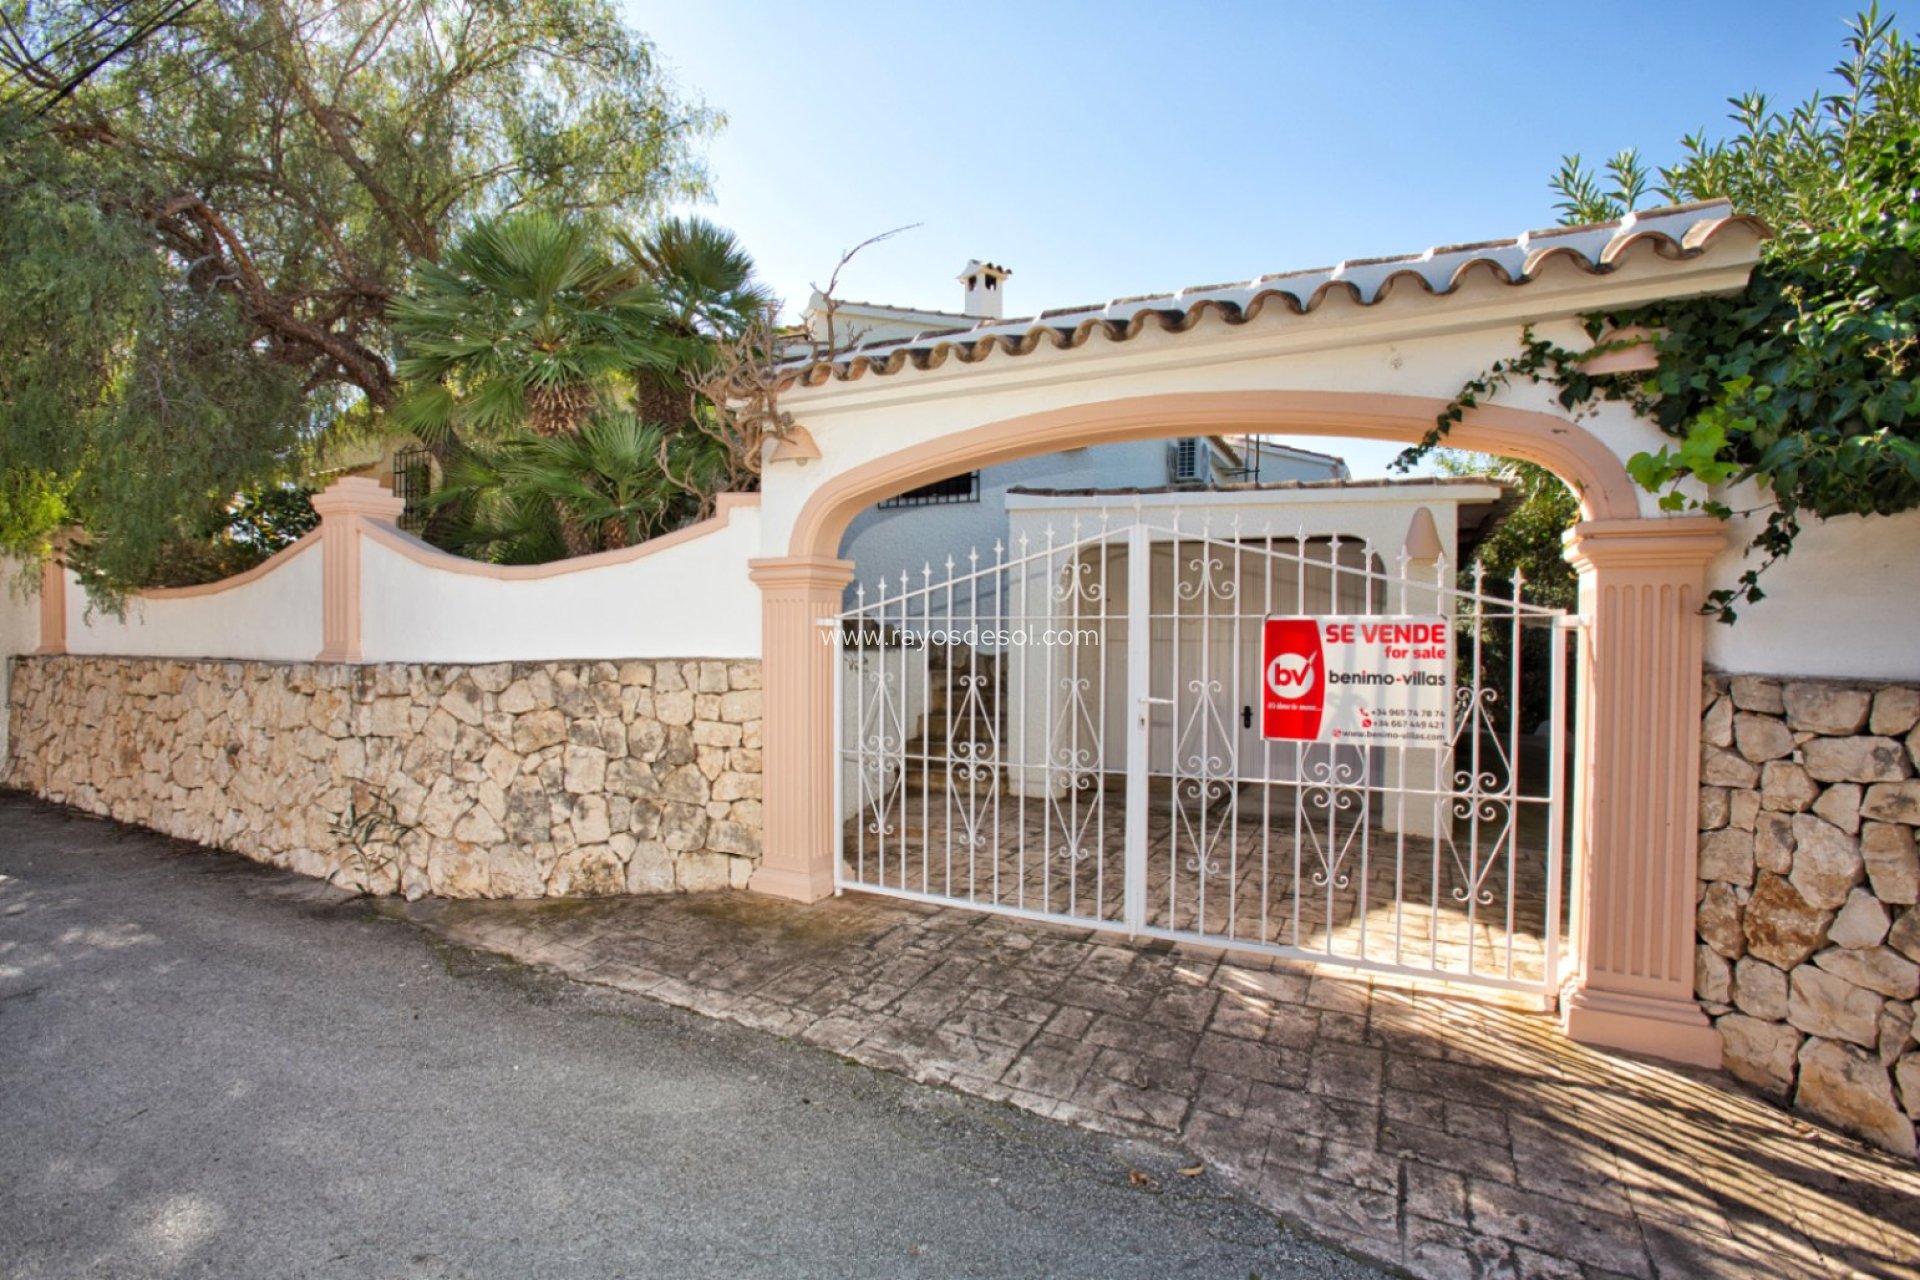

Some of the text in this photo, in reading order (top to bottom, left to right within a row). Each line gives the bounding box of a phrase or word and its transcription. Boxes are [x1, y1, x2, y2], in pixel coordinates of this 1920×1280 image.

[1326, 624, 1446, 643] SE VENDE
[1384, 646, 1446, 659] for sale
[1274, 659, 1313, 686] bv
[1328, 670, 1446, 686] benimo-villas
